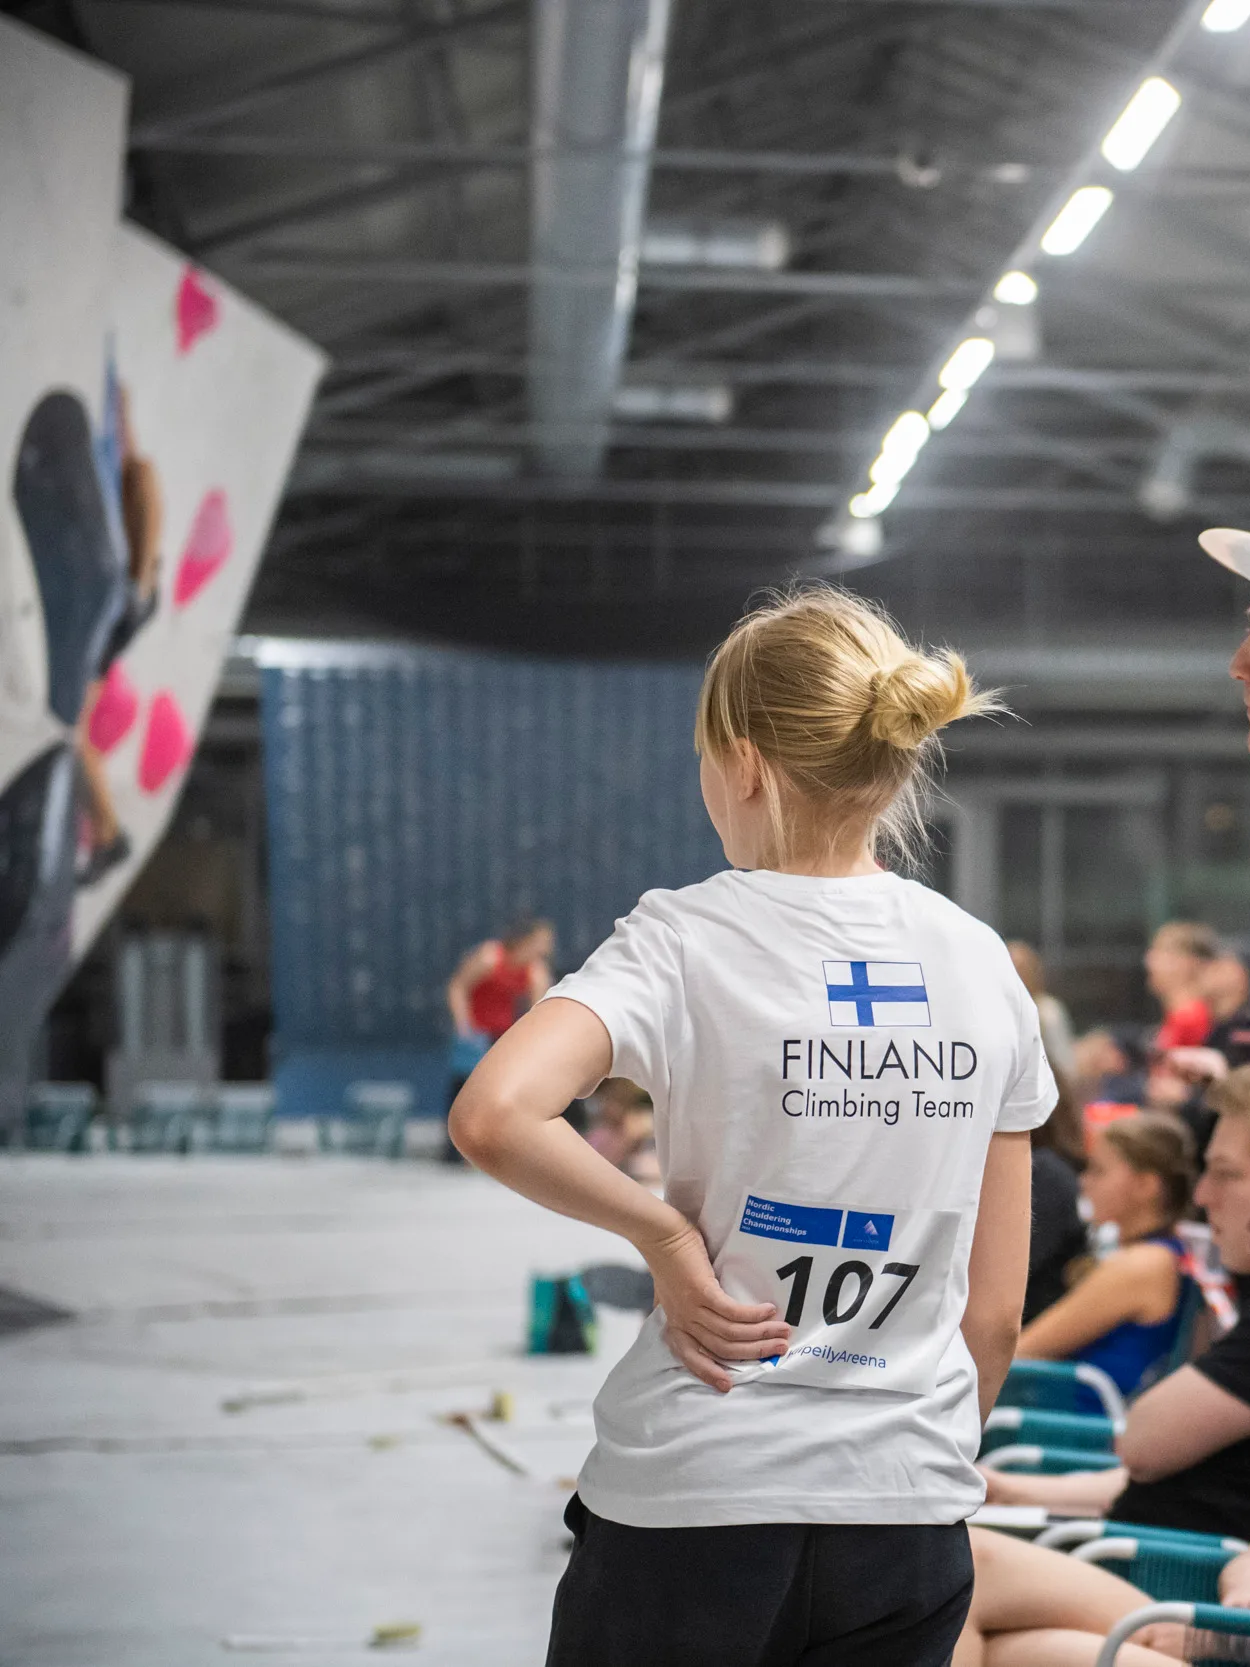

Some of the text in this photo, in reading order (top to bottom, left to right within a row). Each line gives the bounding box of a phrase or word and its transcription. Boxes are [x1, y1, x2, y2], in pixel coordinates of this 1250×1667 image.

[781, 1039, 978, 1081] FINLAND
[781, 1088, 974, 1126] Climbing Team
[745, 1208, 792, 1226] Bouldering
[747, 1198, 775, 1212] Nordic
[743, 1217, 808, 1237] Championships
[776, 1255, 921, 1330] 107
